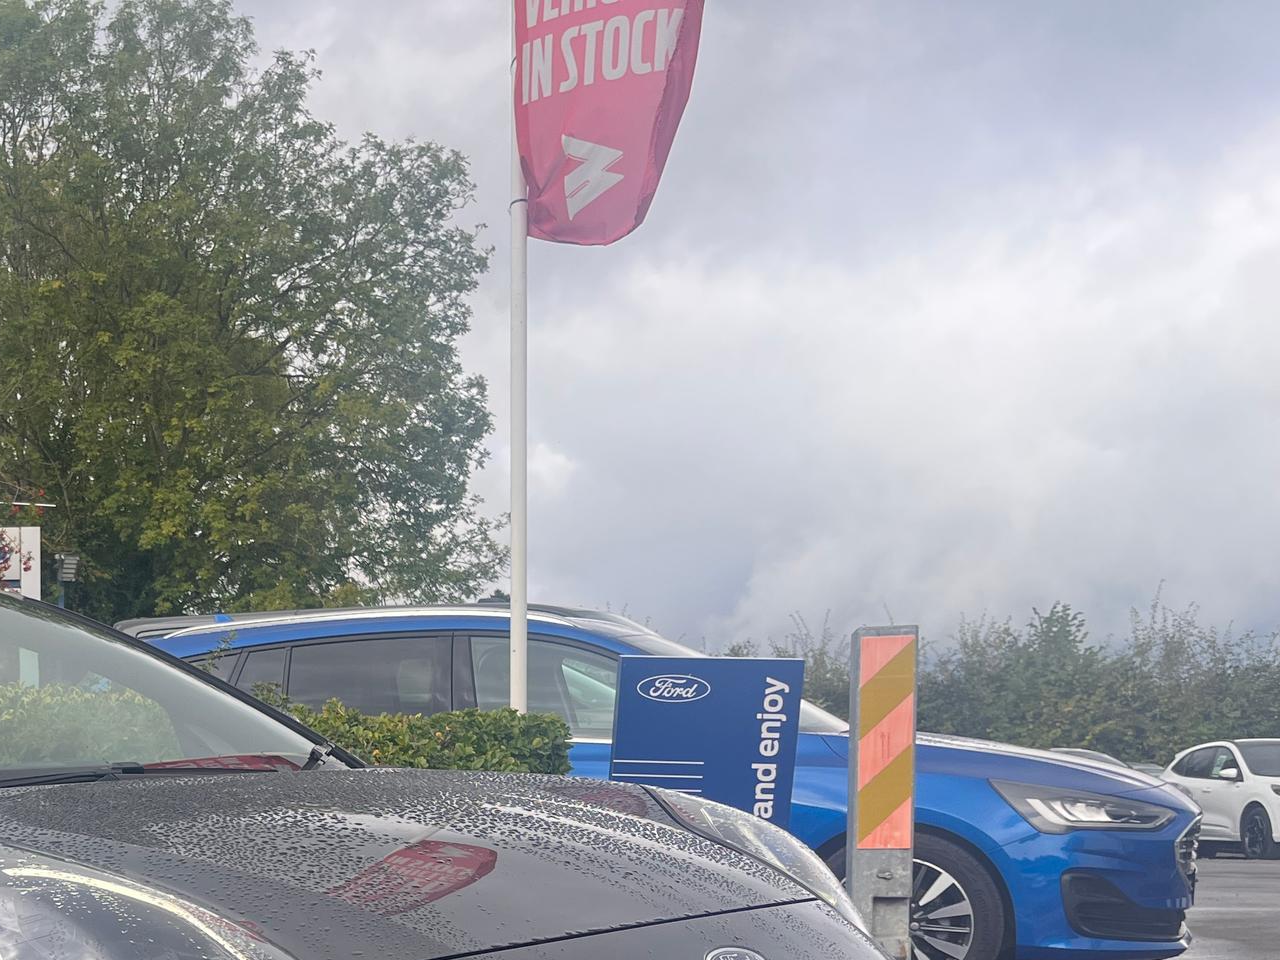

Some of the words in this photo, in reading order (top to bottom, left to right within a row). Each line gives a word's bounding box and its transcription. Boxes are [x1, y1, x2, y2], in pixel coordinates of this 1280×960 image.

[521, 34, 554, 106] IN
[559, 8, 685, 93] STOCK
[649, 676, 699, 699] Ford
[756, 676, 790, 757] enjoy
[751, 763, 777, 819] and
